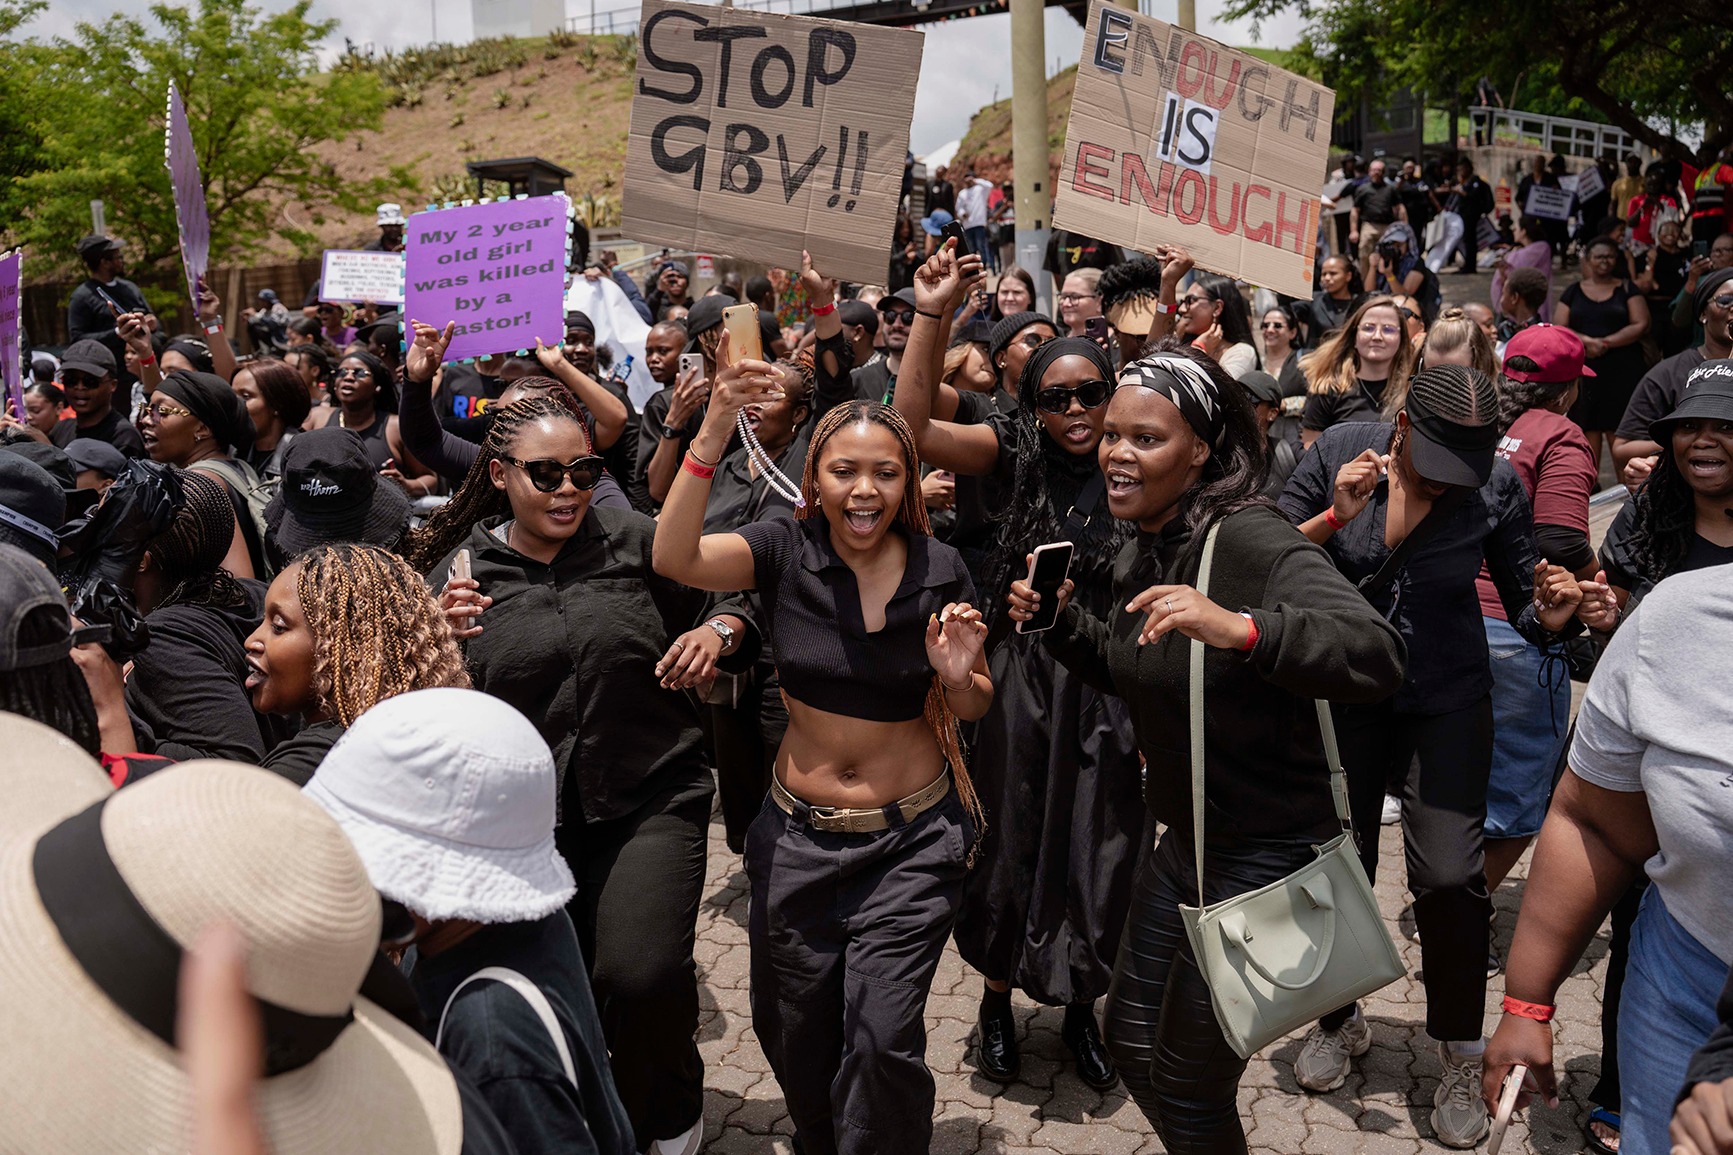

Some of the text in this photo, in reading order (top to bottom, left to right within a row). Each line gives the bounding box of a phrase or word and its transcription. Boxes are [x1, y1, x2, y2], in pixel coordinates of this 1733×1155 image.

[639, 9, 857, 109] STOP
[1093, 6, 1321, 143] ENOUGH
[1161, 98, 1214, 166] IS
[651, 115, 869, 212] GBV!!
[419, 217, 554, 245] My 2 year
[1071, 141, 1321, 282] ENOUGH!
[414, 259, 555, 292] was killed
[437, 239, 532, 265] old girl
[437, 311, 532, 338] astor!
[455, 292, 512, 312] by a
